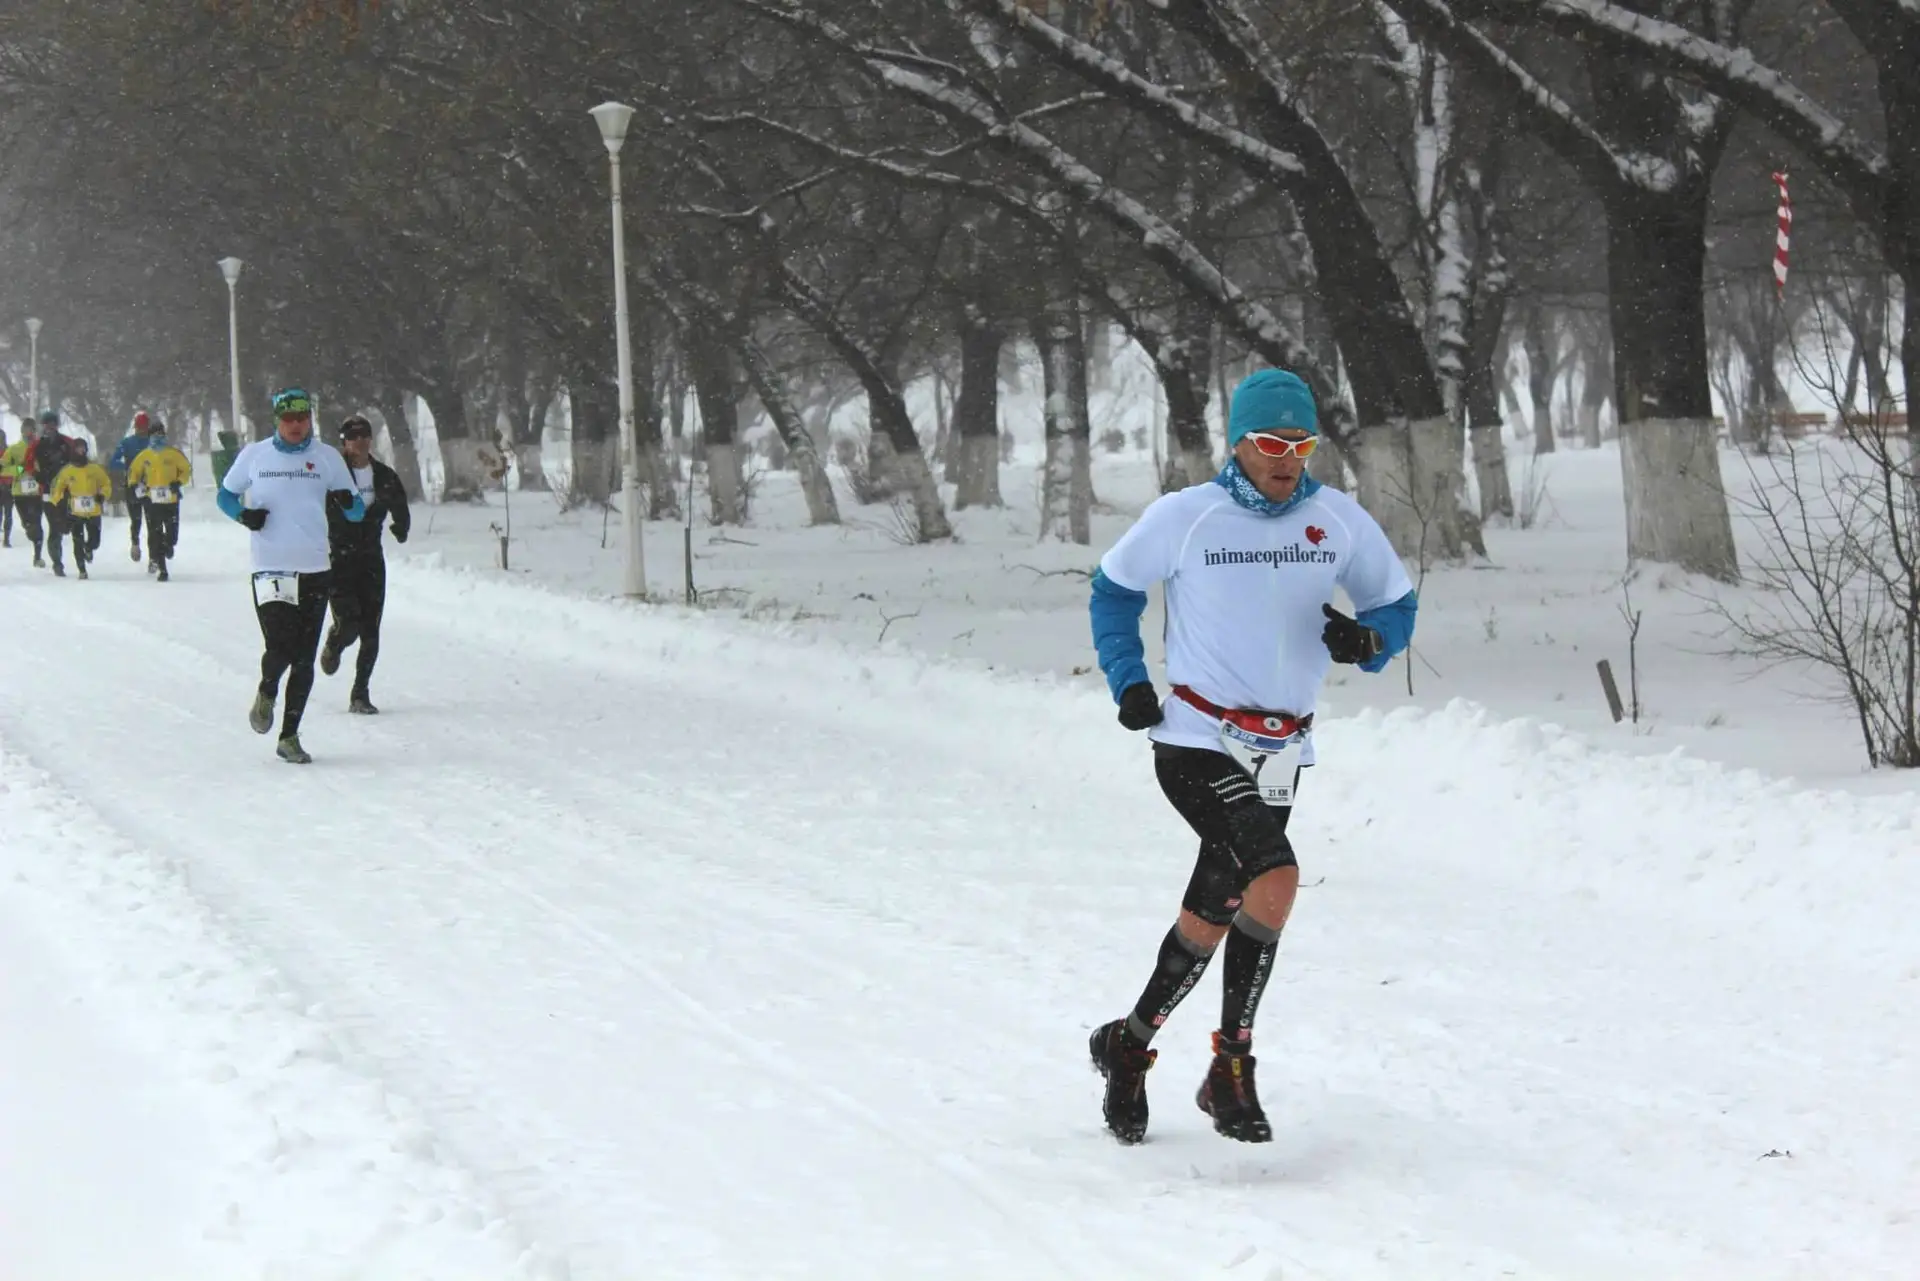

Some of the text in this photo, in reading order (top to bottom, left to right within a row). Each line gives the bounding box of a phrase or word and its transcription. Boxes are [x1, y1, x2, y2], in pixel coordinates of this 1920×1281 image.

[1204, 543, 1336, 569] inimacopiilor.ro
[271, 579, 280, 593] 1
[1251, 753, 1267, 780] 1
